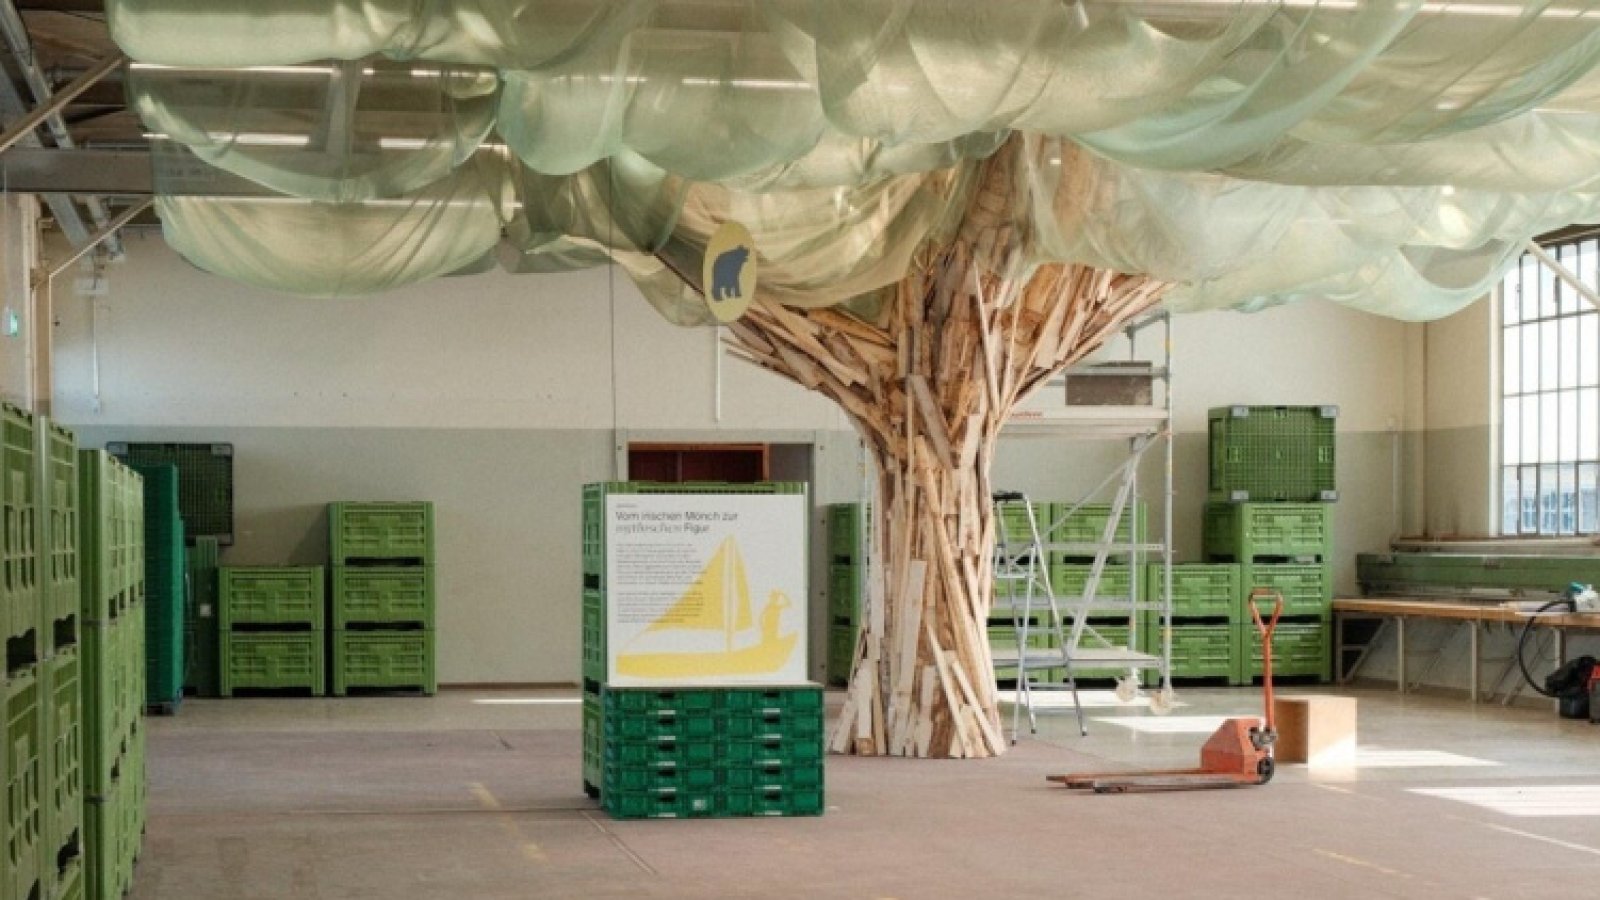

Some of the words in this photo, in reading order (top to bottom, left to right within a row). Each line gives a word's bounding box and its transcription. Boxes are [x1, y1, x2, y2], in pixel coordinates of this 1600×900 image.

[615, 511, 640, 521] Vom
[685, 511, 720, 521] Mönch
[722, 513, 738, 521] zur
[684, 522, 710, 534] Figur
